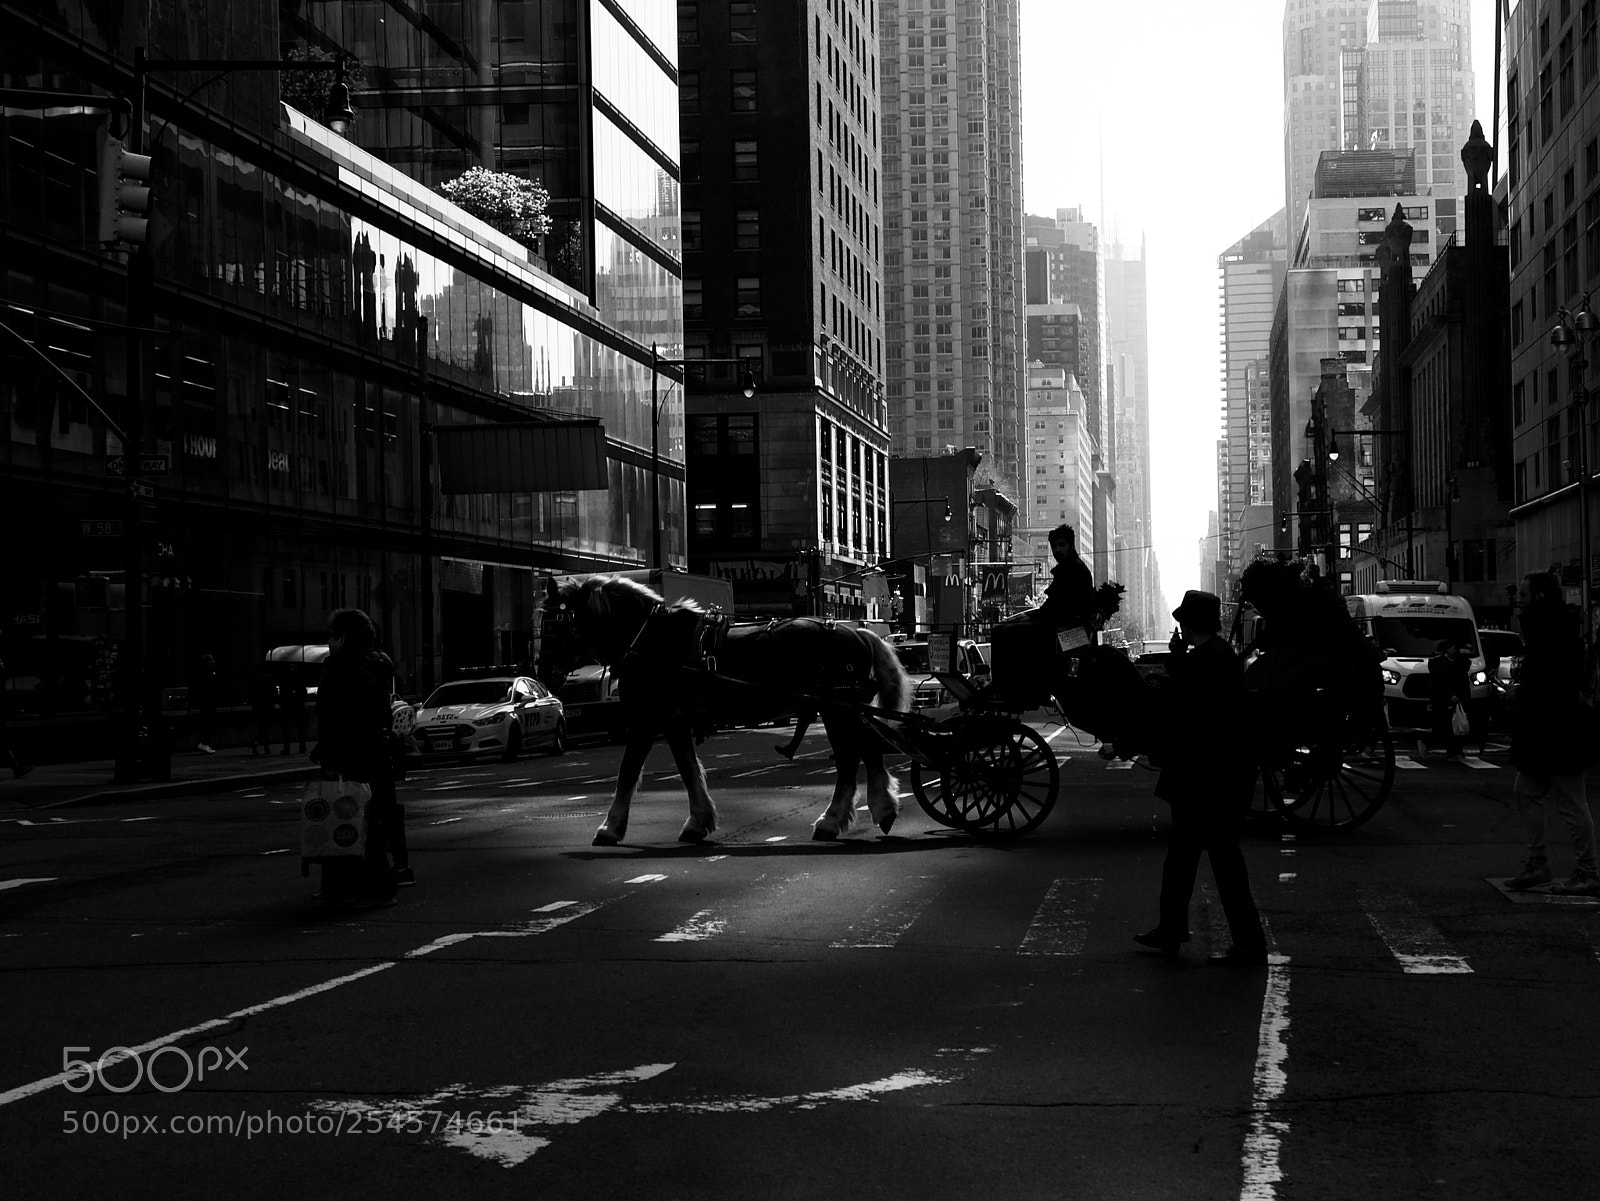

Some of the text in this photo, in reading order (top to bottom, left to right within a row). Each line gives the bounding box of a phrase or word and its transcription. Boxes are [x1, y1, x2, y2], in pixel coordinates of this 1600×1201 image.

[143, 459, 163, 471] WAY
[81, 522, 112, 535] W 58
